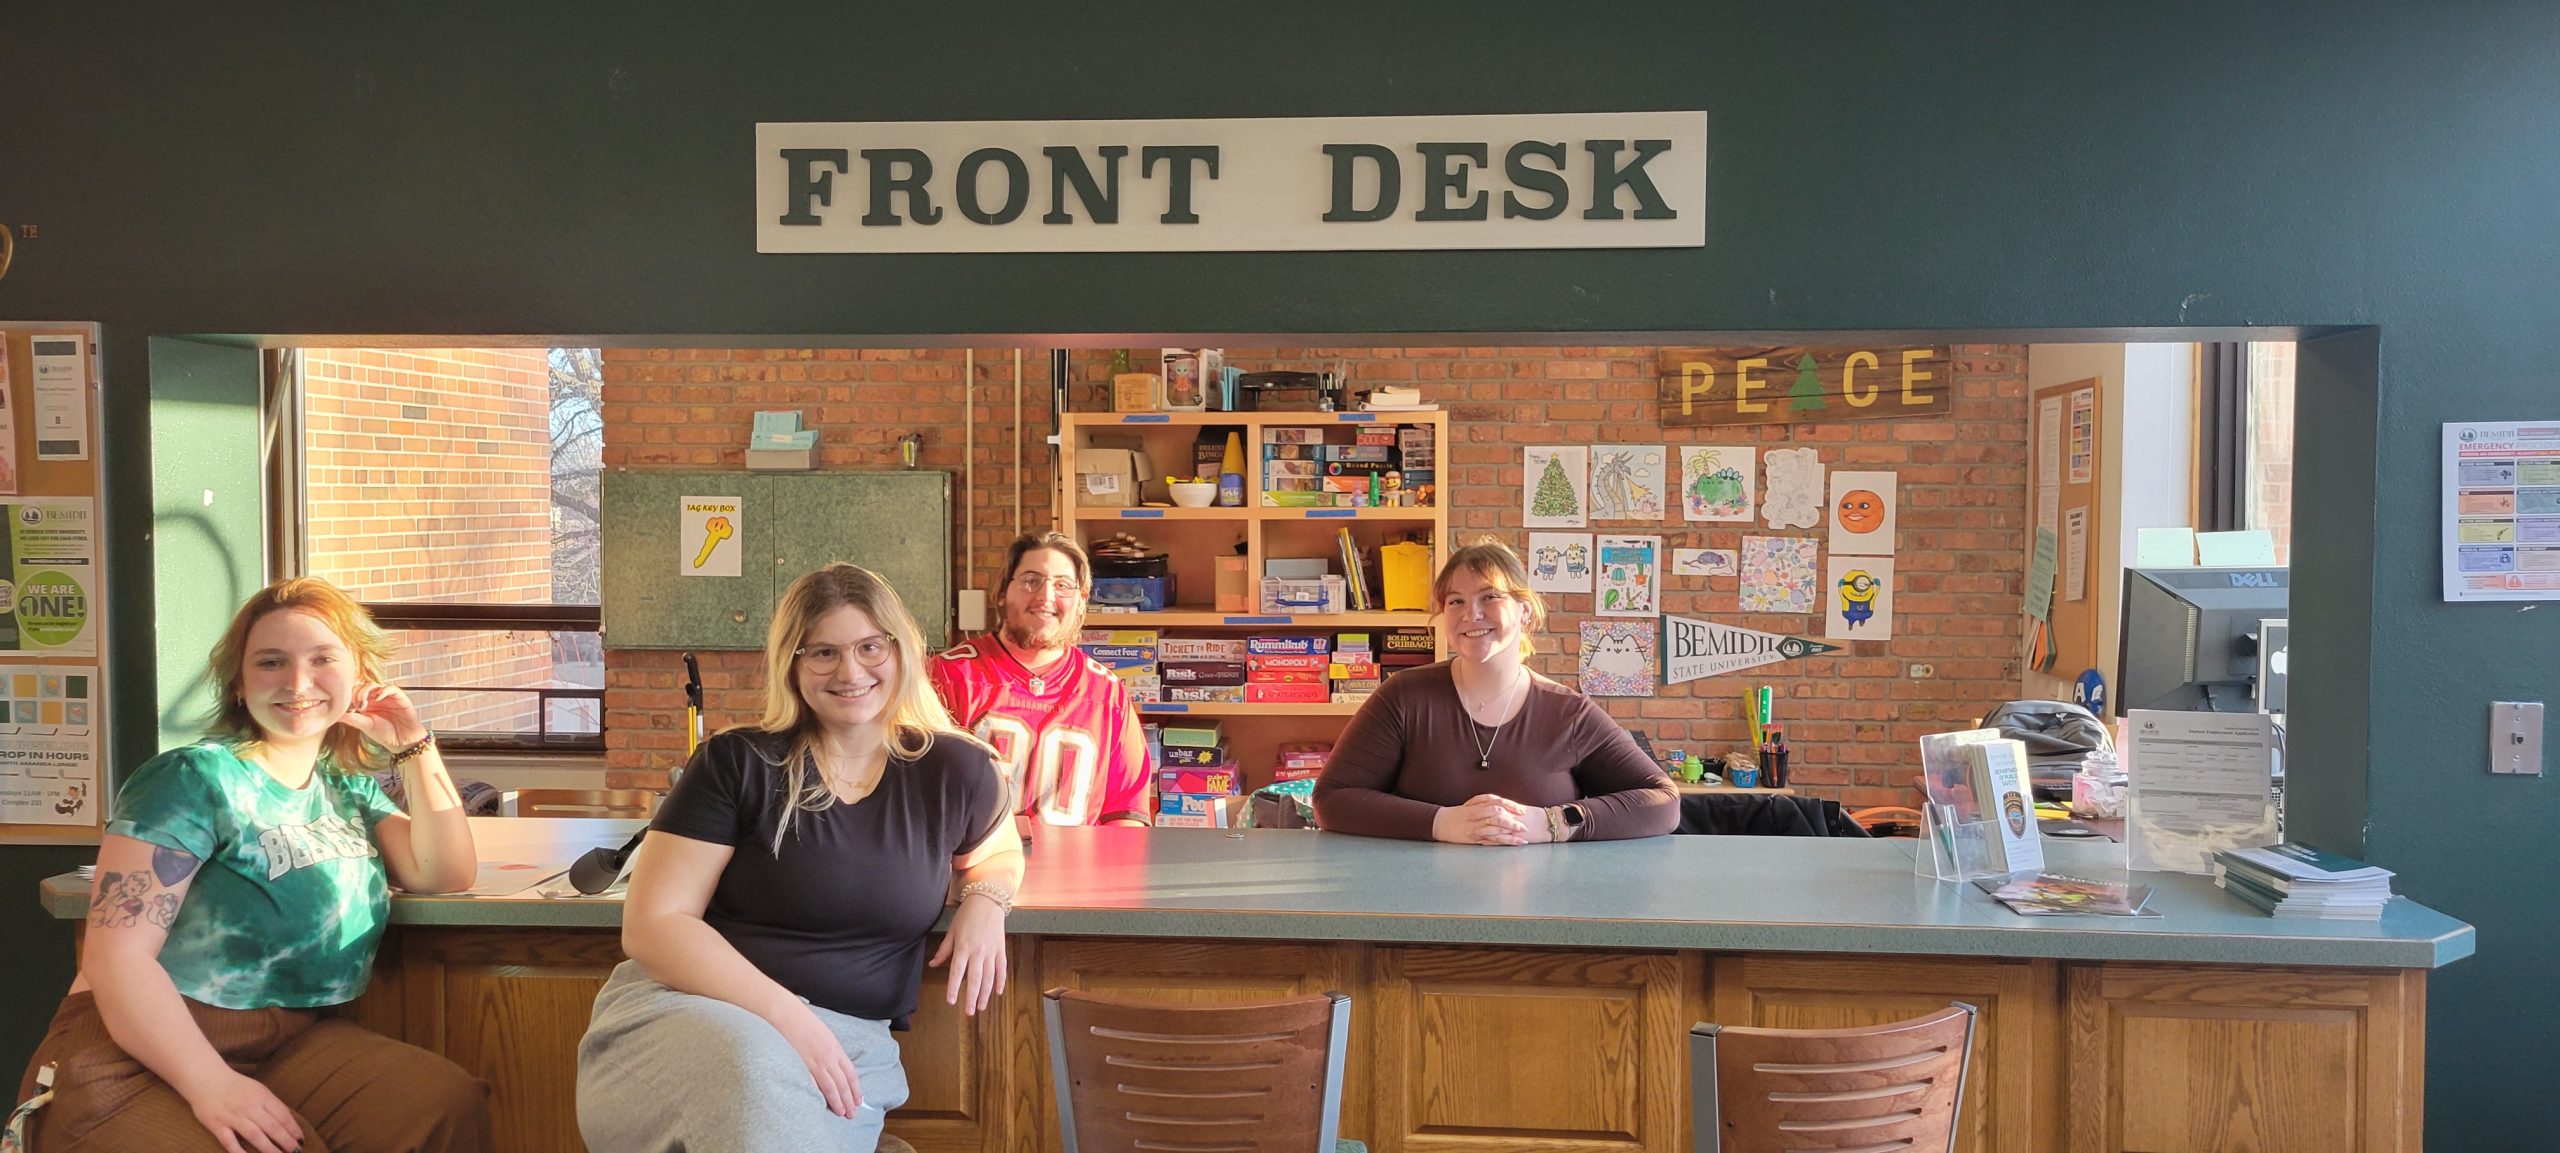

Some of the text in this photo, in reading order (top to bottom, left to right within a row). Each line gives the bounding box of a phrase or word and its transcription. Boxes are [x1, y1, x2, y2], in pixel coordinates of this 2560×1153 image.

[779, 139, 1678, 227] FRONT DESK
[20, 224, 40, 239] TH
[2459, 442, 2514, 450] EMERGENCY
[686, 504, 702, 512] TAG
[719, 504, 736, 513] BOX
[2230, 572, 2278, 587] DELL
[27, 584, 75, 595] WE ARE
[18, 595, 85, 618] ONE!
[1672, 620, 1776, 658] BEMIDJI
[1163, 642, 1195, 654] TICKET
[1205, 642, 1228, 653] RIDE
[1250, 639, 1309, 653] Rummikub
[1386, 641, 1434, 650] CRIBBAGE
[1092, 647, 1139, 657] Connect Four
[1264, 658, 1309, 667] MONOPOLY
[1347, 664, 1368, 673] CATAN
[1673, 664, 1705, 680] STATE
[0, 751, 90, 761] ROP IN HOURS
[1206, 779, 1230, 793] FAME
